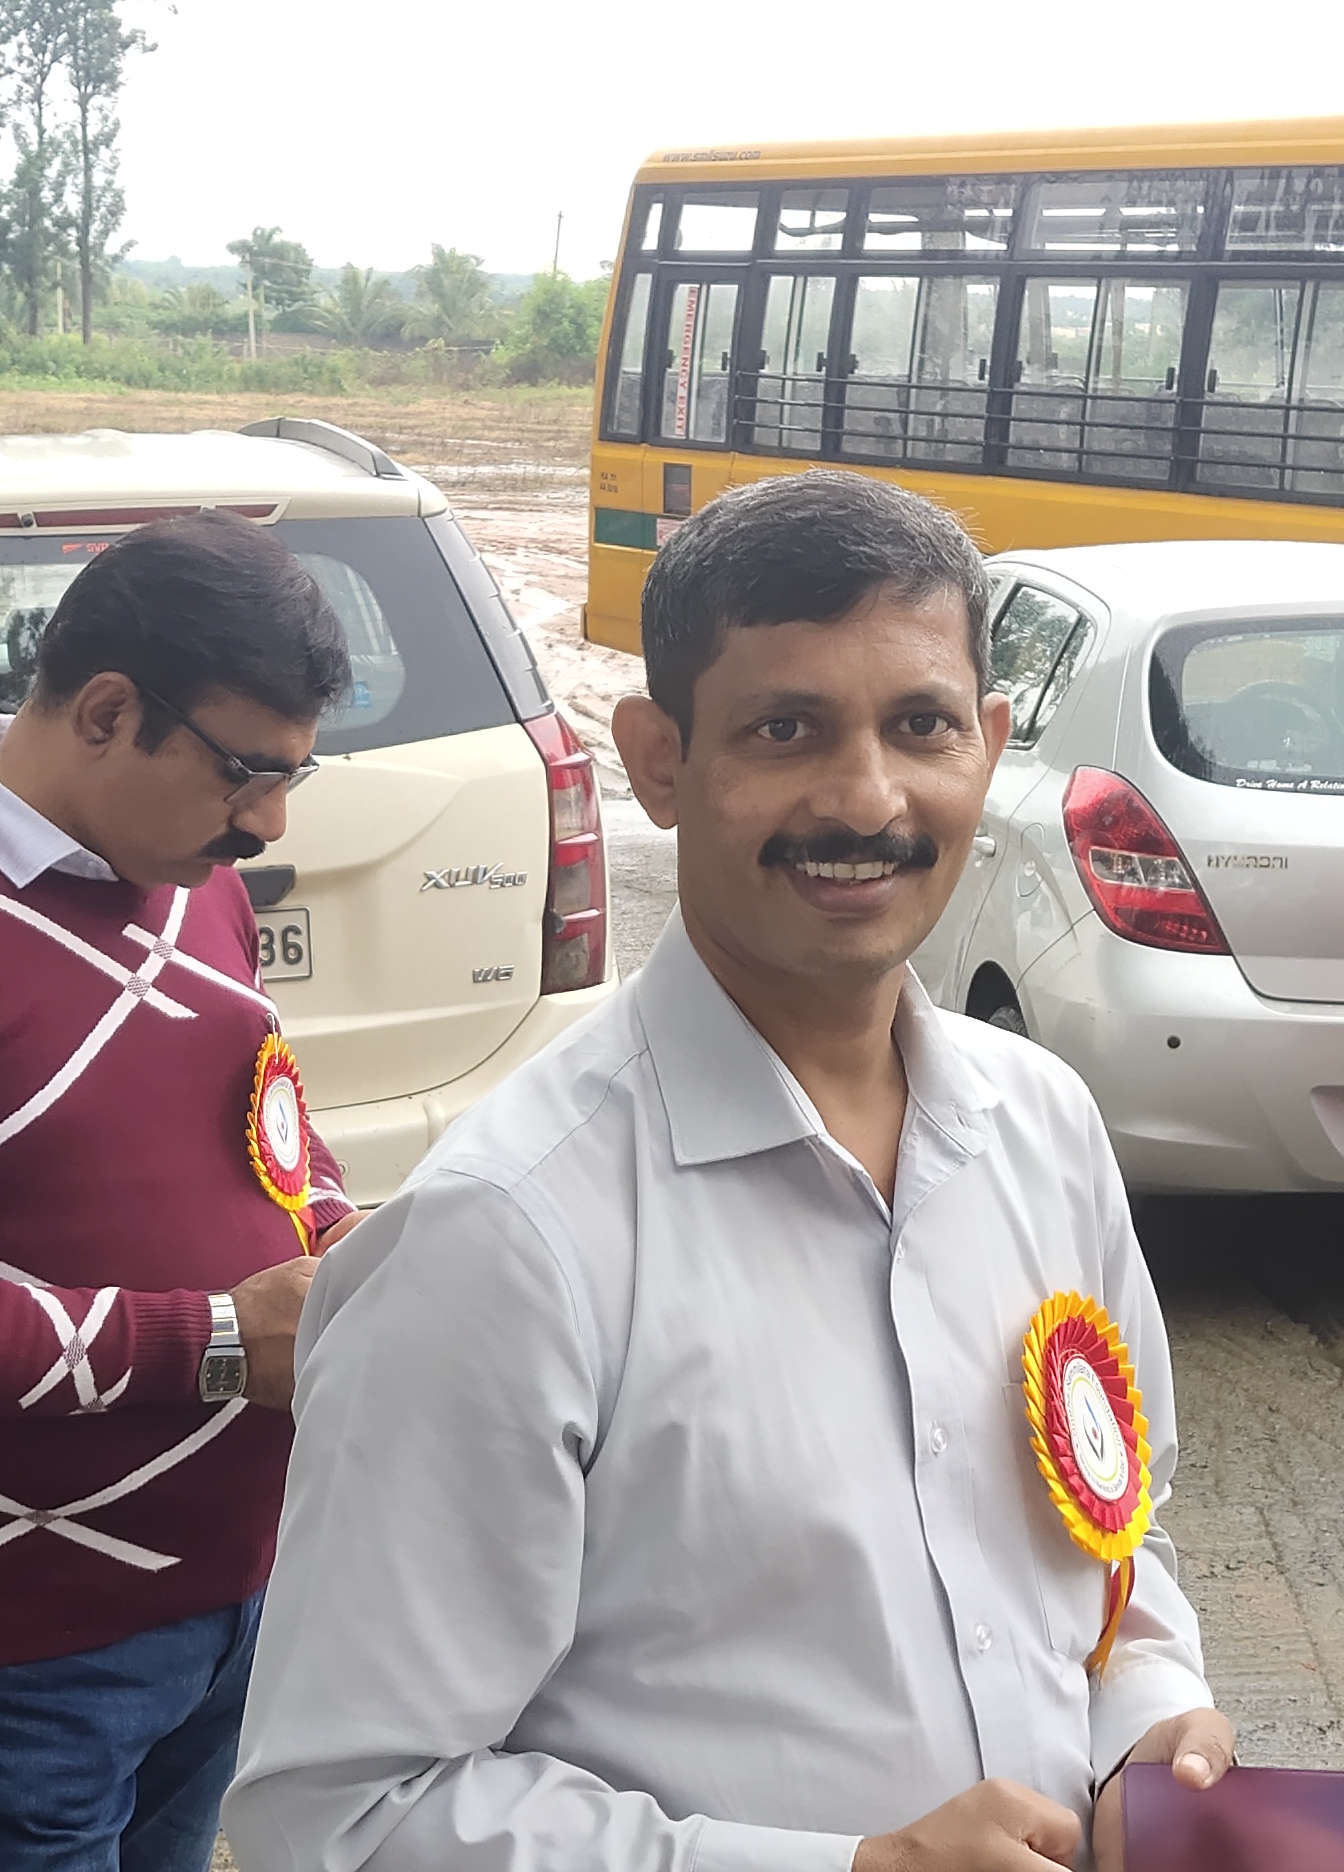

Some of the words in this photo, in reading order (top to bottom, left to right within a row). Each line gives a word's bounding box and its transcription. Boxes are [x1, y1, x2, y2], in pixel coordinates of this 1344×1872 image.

[678, 287, 698, 389] EMERGENCY
[674, 395, 687, 431] EXIT
[1236, 778, 1263, 788] Drive
[1266, 779, 1294, 789] Home
[1297, 780, 1308, 789] A
[1207, 854, 1289, 869] HYUNDAI
